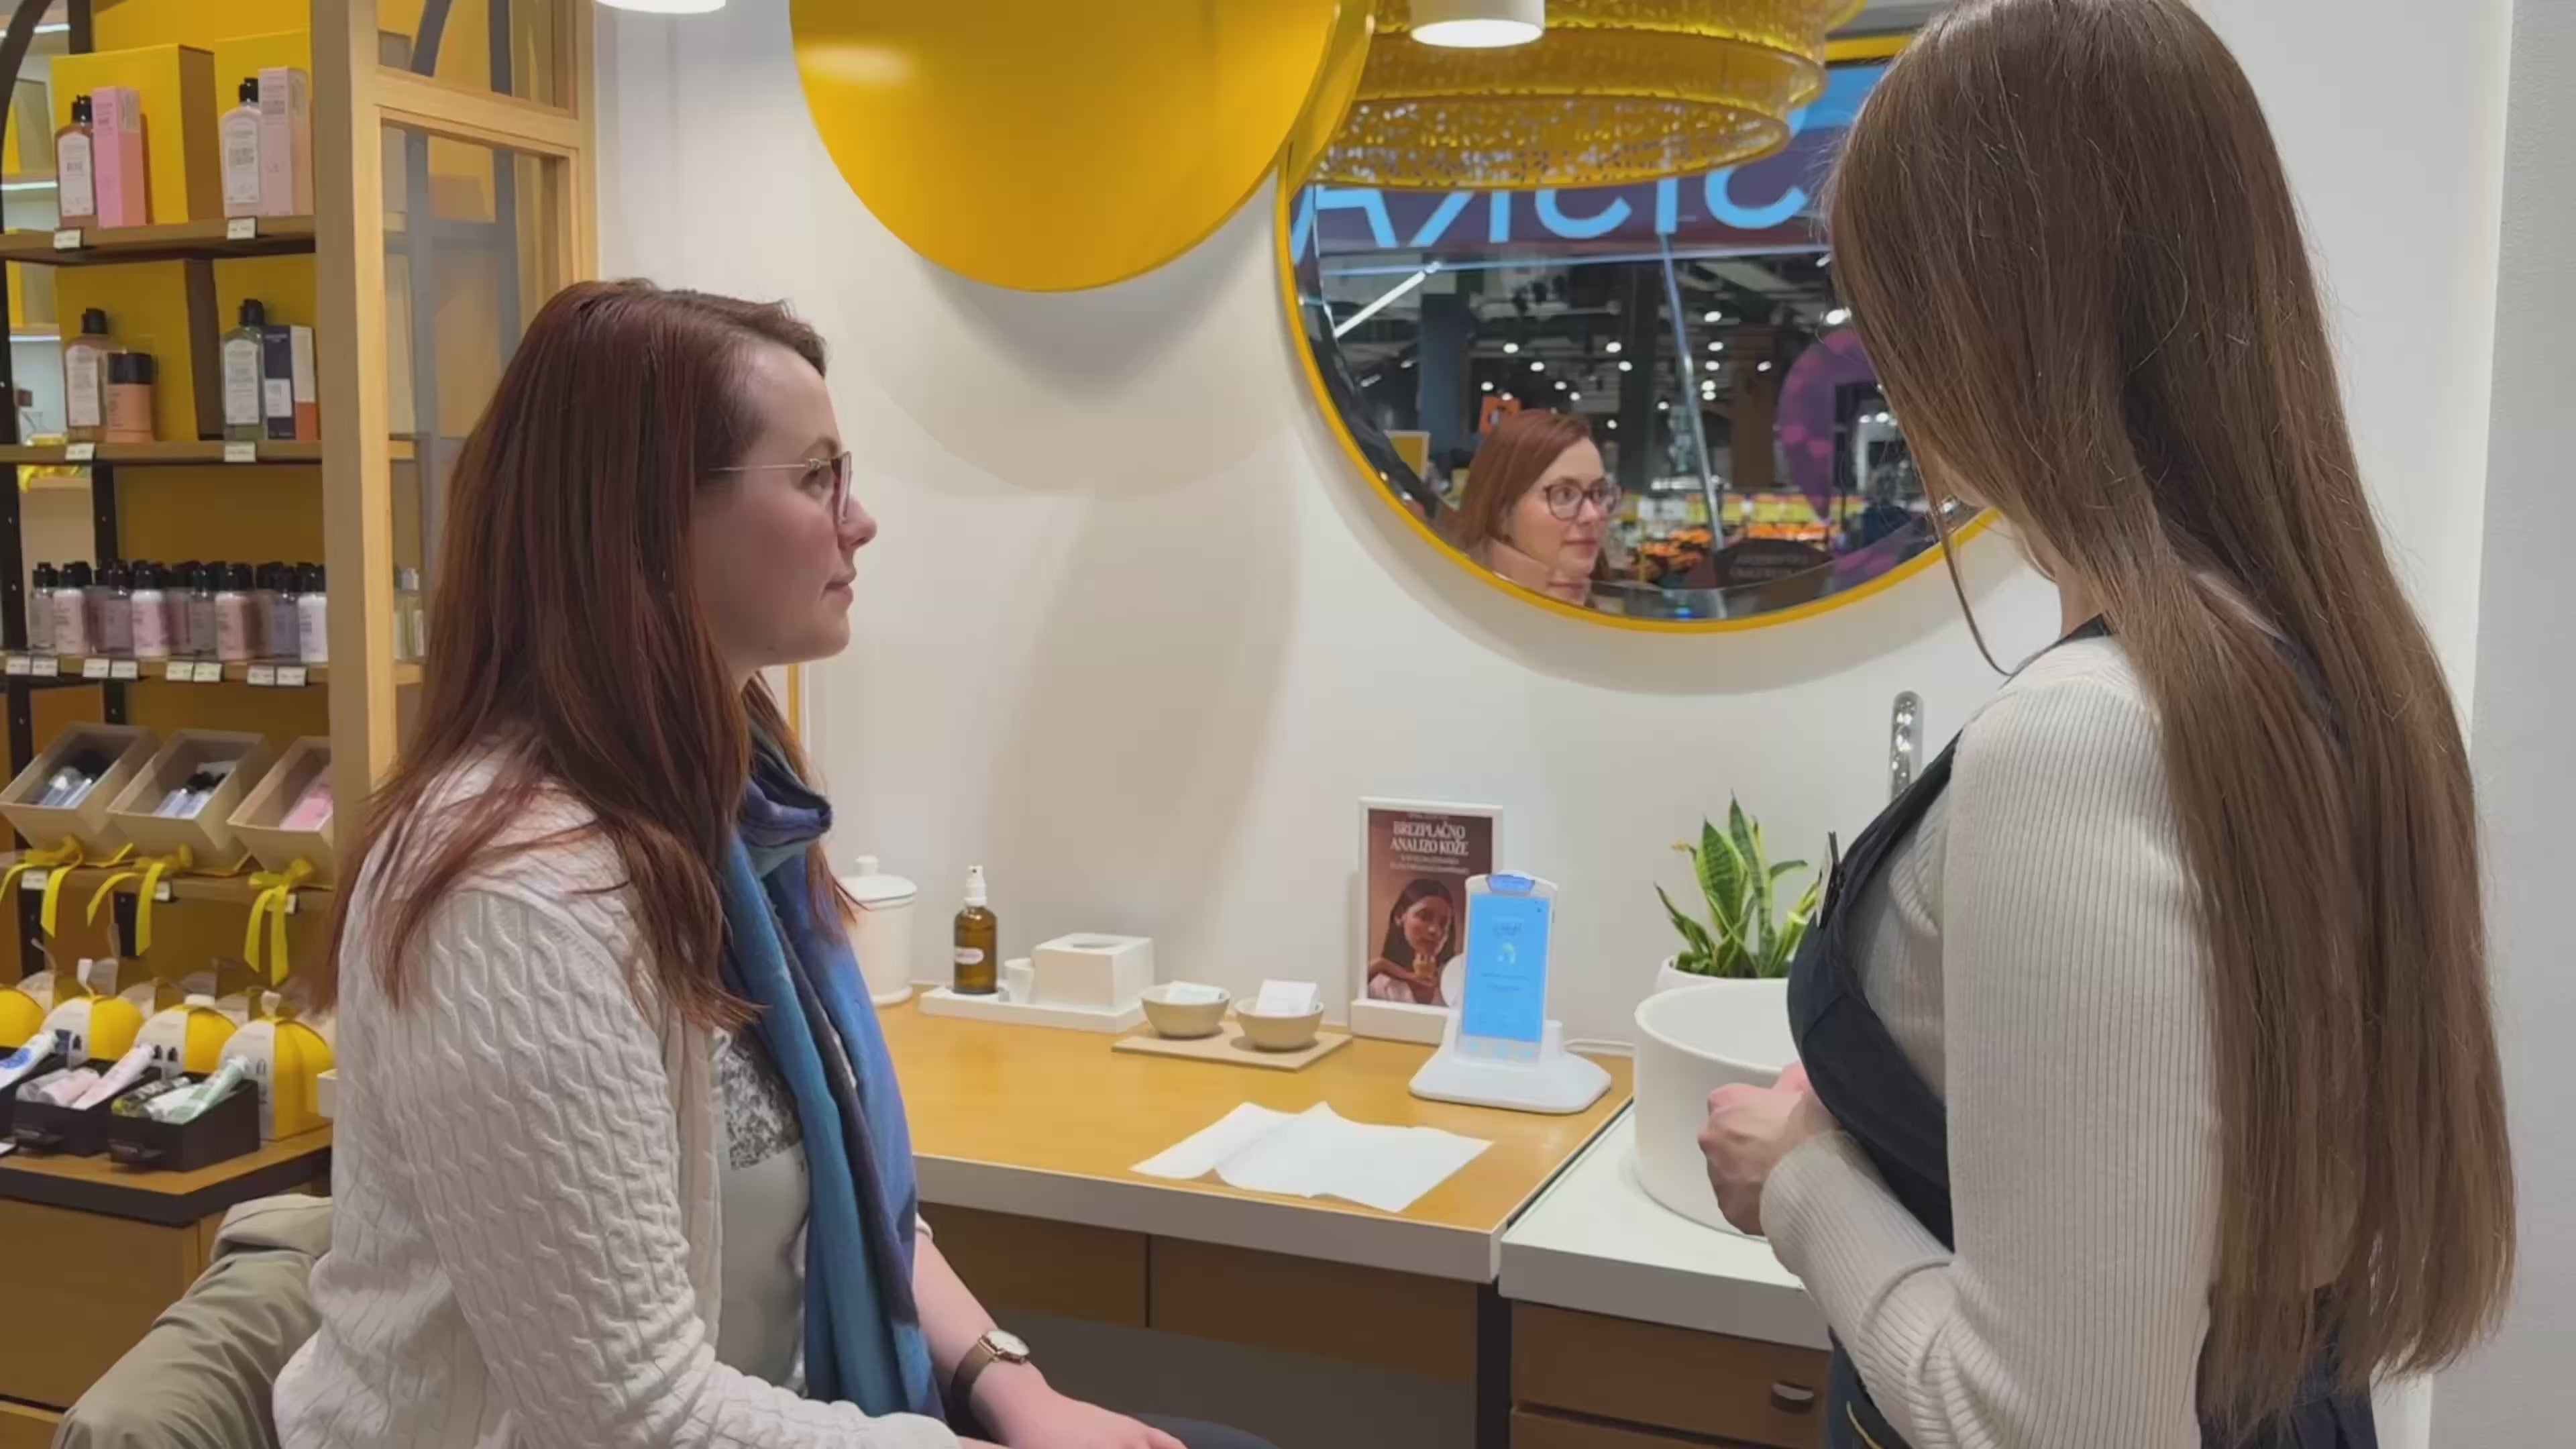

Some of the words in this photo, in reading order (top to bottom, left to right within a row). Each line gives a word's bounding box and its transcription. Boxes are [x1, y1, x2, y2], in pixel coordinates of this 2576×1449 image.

[1393, 821, 1466, 839] BREZPLAČNO
[1390, 838, 1438, 853] ANALIZO
[1440, 838, 1469, 856] KOŽE
